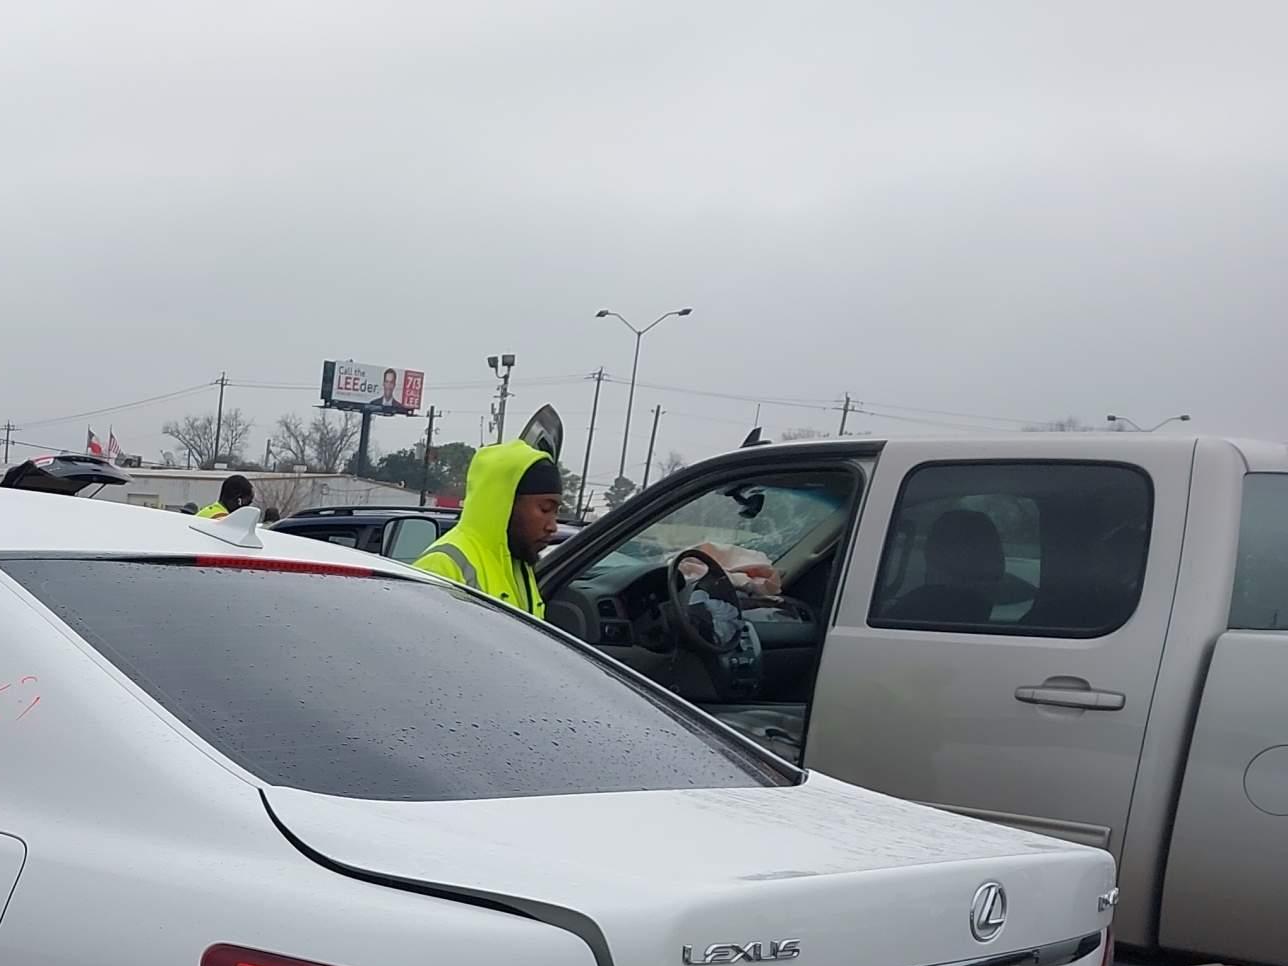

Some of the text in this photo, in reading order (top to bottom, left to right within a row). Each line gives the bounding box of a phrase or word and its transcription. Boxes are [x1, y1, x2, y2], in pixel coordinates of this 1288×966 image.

[338, 366, 366, 378] Call the
[682, 939, 801, 966] LEXUS
